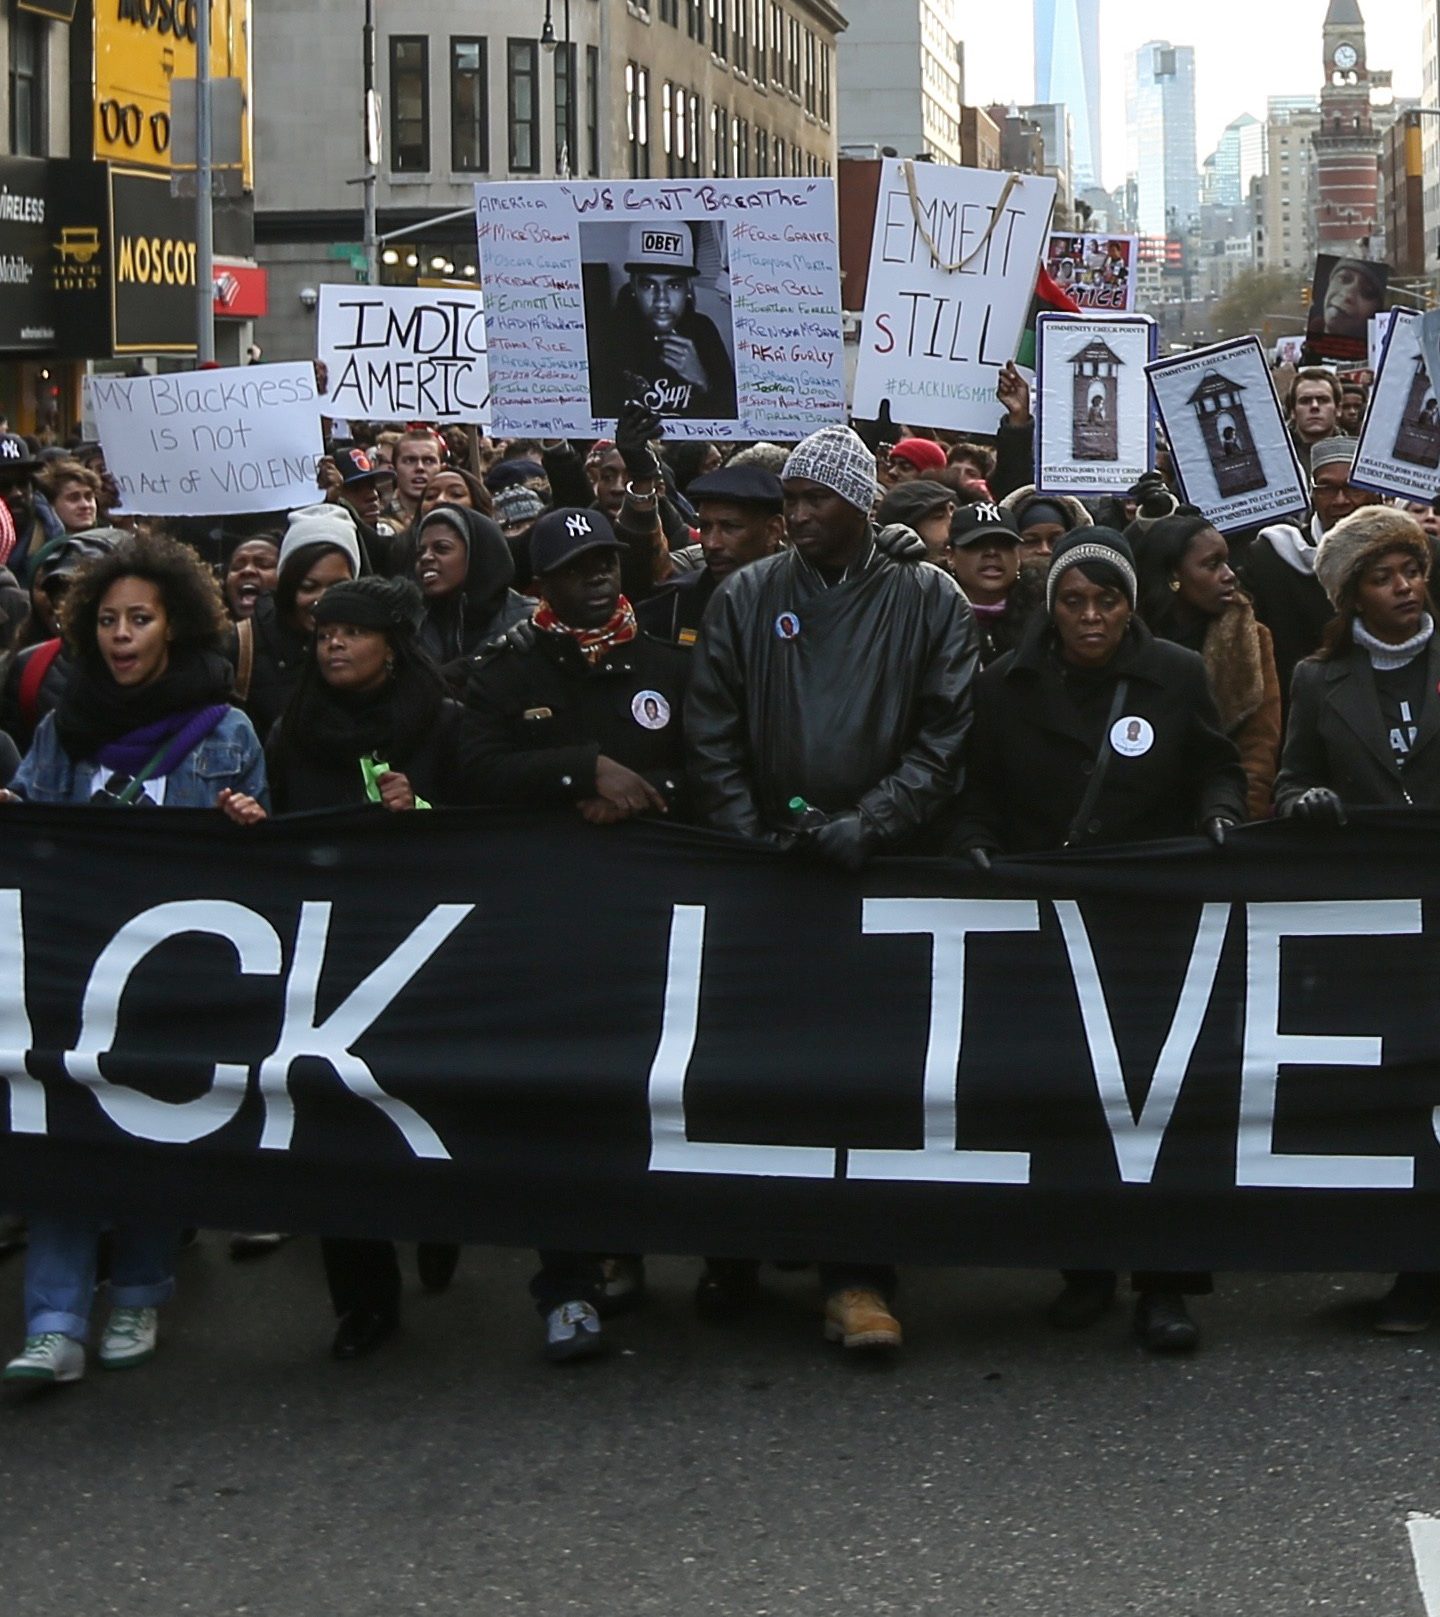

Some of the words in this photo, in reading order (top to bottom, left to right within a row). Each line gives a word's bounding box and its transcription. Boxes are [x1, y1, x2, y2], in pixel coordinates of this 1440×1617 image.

[644, 235, 681, 253] OBEY
[881, 190, 1027, 278] EMMETT
[118, 234, 198, 287] MOSCOT
[54, 278, 98, 290] 1915
[333, 300, 487, 363] INDIC
[1046, 324, 1092, 333] COMMUNITY
[1154, 360, 1202, 381] COMMUNITY
[1201, 352, 1228, 368] CHECK
[1228, 345, 1257, 361] POINTS
[92, 380, 135, 412] MY
[149, 376, 314, 417] Blackness
[191, 417, 253, 452] not
[140, 471, 169, 494] Act
